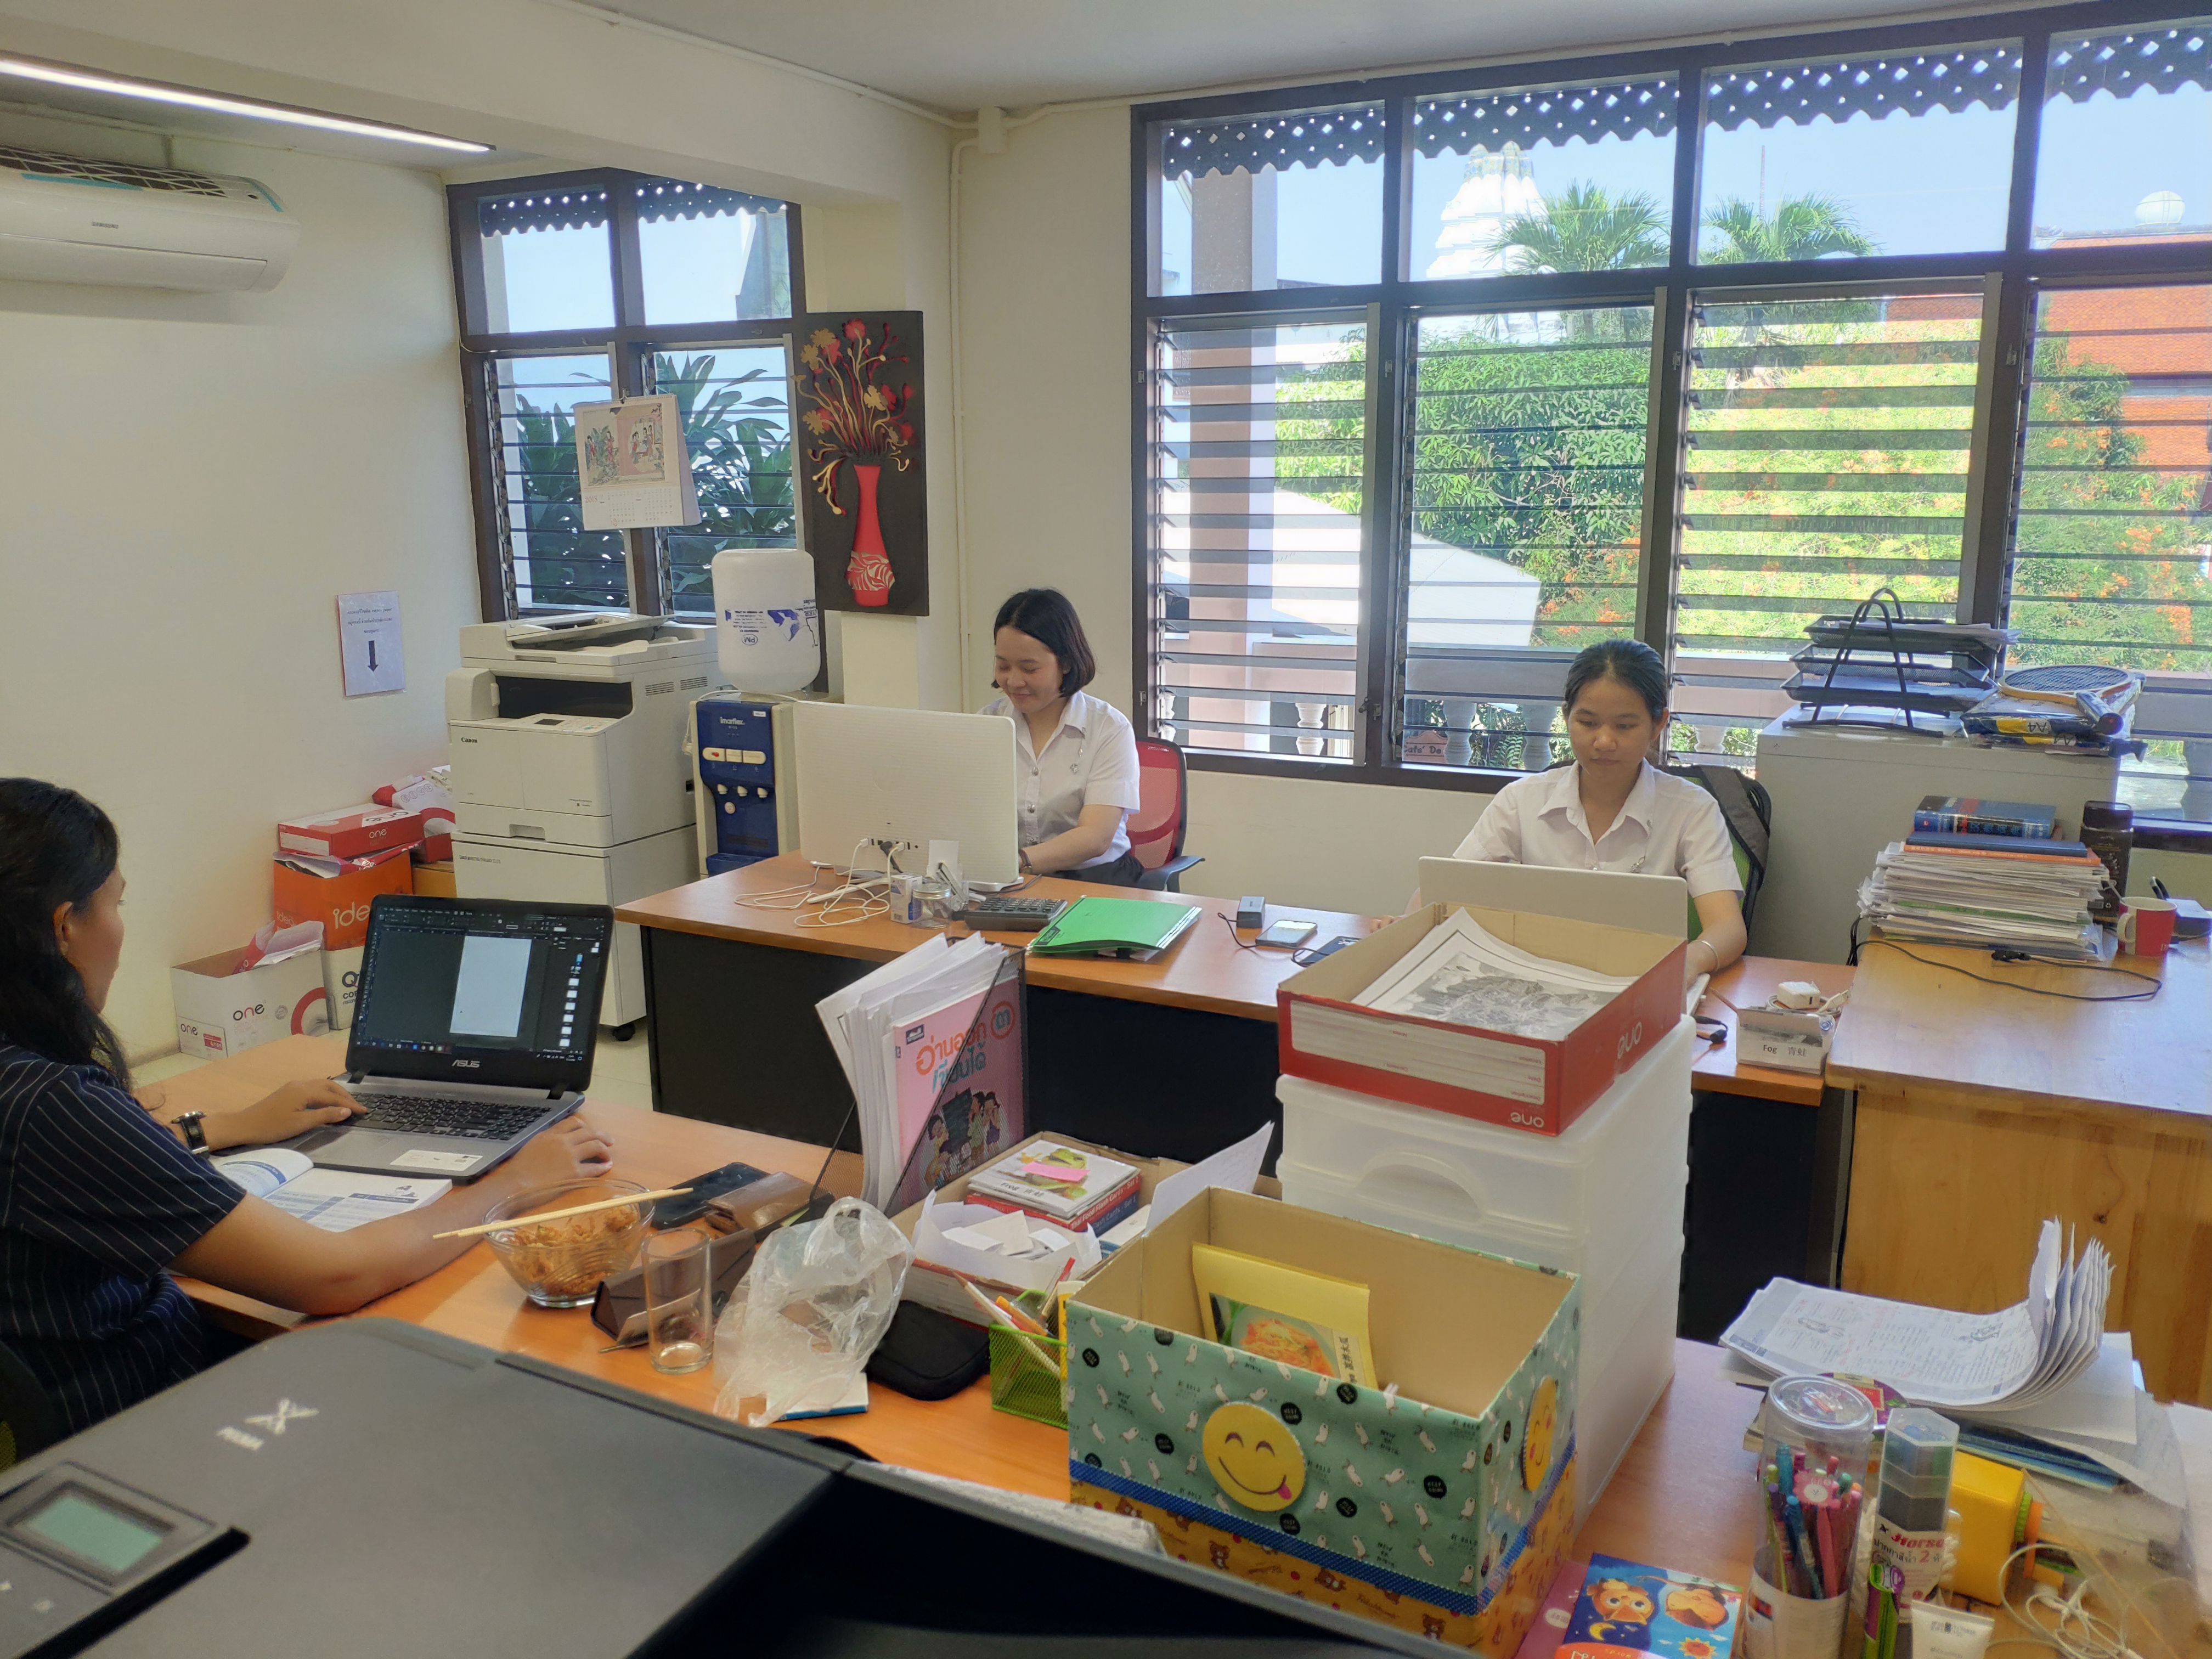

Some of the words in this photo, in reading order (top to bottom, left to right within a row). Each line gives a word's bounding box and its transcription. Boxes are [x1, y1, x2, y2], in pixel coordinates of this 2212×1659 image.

[2027, 721, 2047, 733] A4
[369, 828, 387, 839] one
[332, 901, 371, 929] ide
[233, 1003, 265, 1021] one
[180, 1023, 198, 1036] one
[1617, 1021, 1643, 1060] one
[1763, 1045, 1777, 1054] Fog
[452, 1059, 481, 1068] ASUS
[1509, 1111, 1544, 1128] one
[1071, 1216, 1082, 1230] Thai
[1082, 1207, 1095, 1221] Food
[1096, 1197, 1109, 1212] Flash
[1109, 1188, 1124, 1201] Cards
[1890, 1533, 1944, 1549] Horse
[1919, 1550, 1930, 1564] 2
